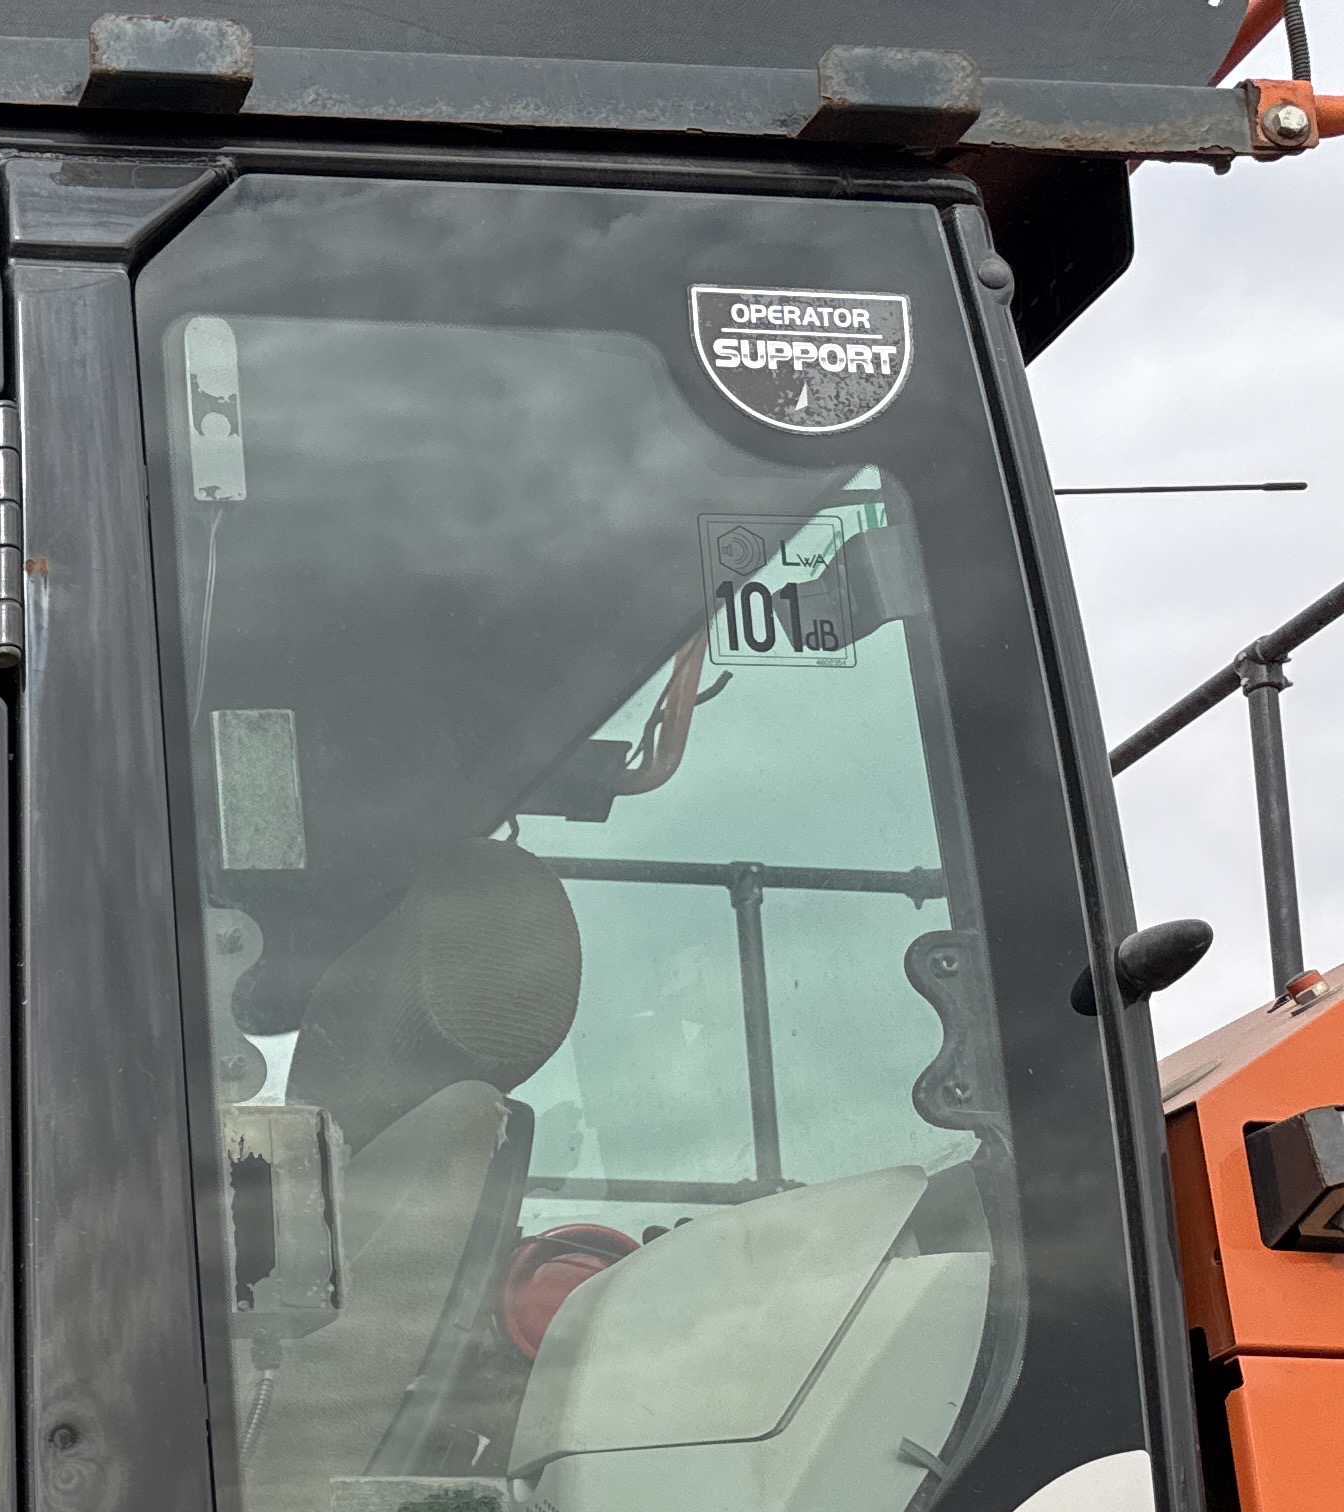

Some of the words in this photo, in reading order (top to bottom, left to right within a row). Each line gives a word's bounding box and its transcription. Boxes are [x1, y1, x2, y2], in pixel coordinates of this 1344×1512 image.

[730, 303, 871, 329] OPERATOR
[712, 338, 897, 375] SUPPORT
[715, 580, 804, 653] 101
[805, 619, 839, 652] dB
